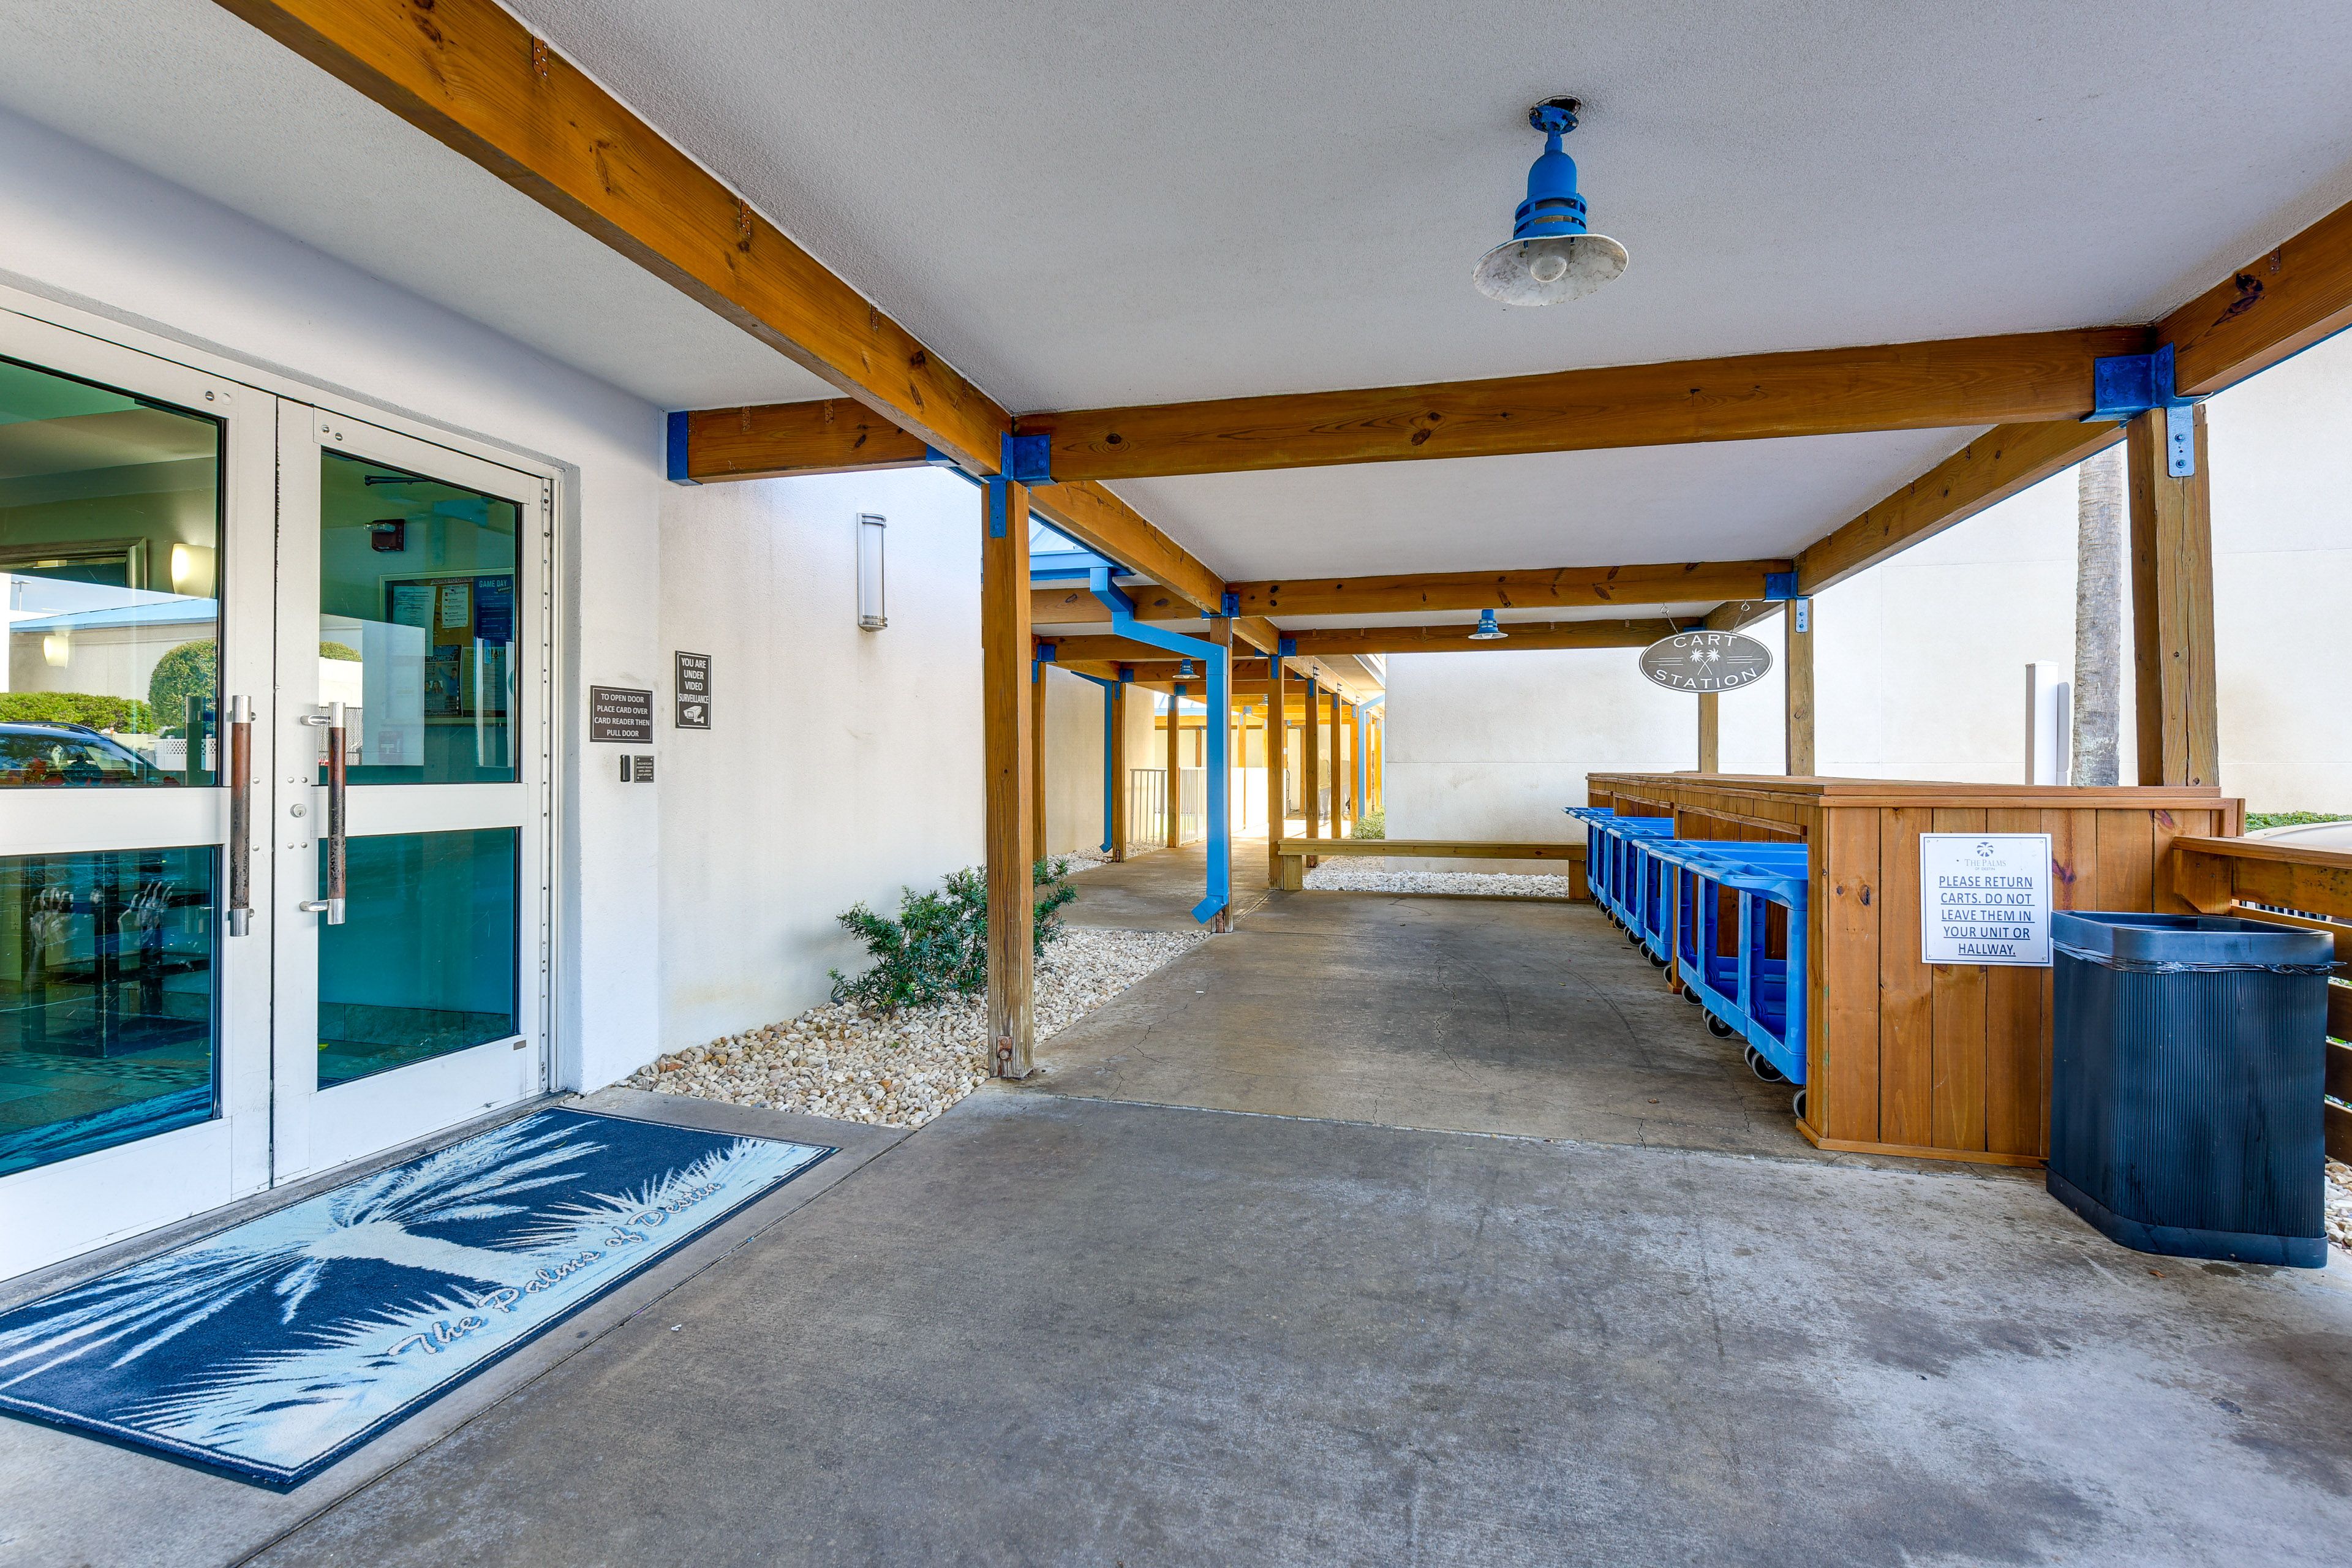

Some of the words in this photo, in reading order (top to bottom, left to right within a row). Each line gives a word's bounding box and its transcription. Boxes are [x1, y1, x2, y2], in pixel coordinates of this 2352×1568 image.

[1673, 634, 1738, 648] CART
[681, 657, 694, 667] YOU
[695, 659, 706, 669] ARE
[684, 669, 704, 680] UNDER
[1654, 668, 1758, 689] STATION
[685, 680, 703, 691] VIDEO
[679, 693, 709, 704] SURVEILLANCE
[1939, 876, 1981, 887] PLEASE
[1985, 876, 2032, 888] RETURN
[1940, 892, 1981, 903] CARTS.
[1986, 893, 2002, 904] DO
[2007, 894, 2032, 904] NOT
[1942, 910, 1977, 920] LEAVE
[1980, 910, 2015, 921] THEM
[2019, 911, 2031, 921] IN
[1943, 926, 1976, 937] YOUR
[1980, 927, 2009, 938] UNIT
[2013, 927, 2030, 938] OR
[1959, 943, 2016, 955] HALLWAY.
[388, 1314, 483, 1355] The
[478, 1249, 601, 1313] Palms
[605, 1224, 645, 1248] of
[627, 1181, 723, 1227] Destin
